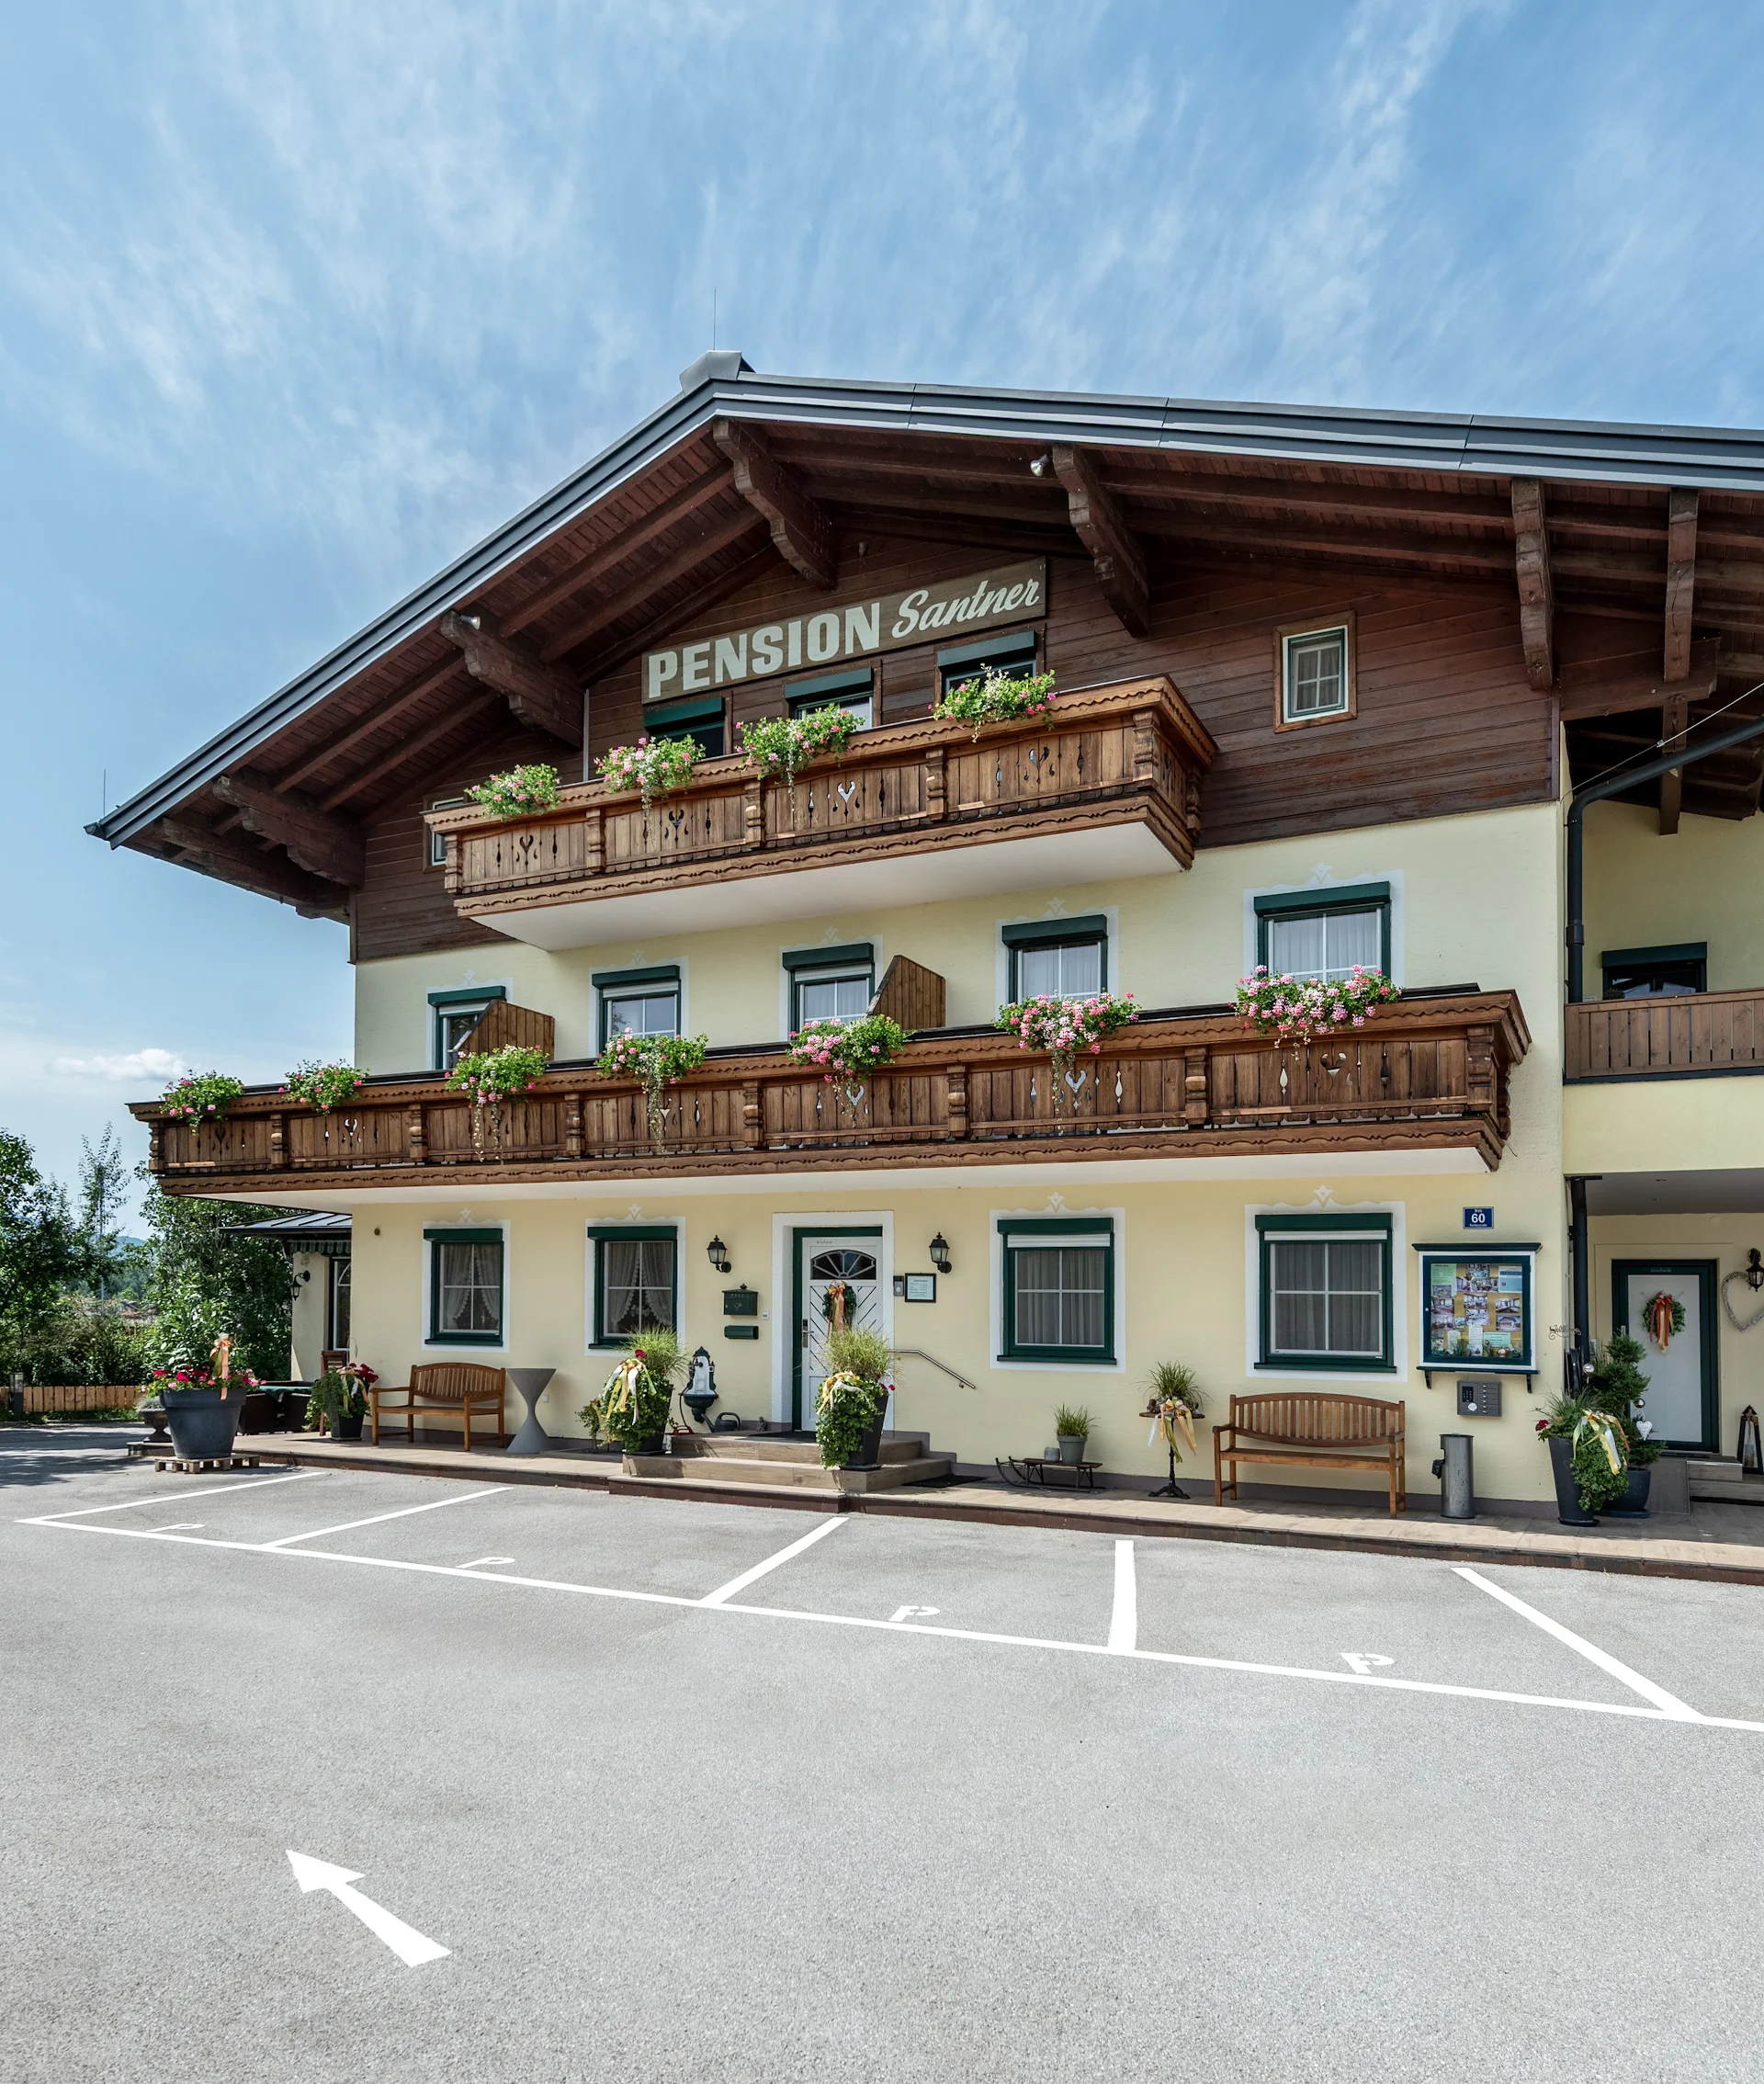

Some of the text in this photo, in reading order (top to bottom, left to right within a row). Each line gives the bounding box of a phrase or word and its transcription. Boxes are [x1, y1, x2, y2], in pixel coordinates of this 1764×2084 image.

[649, 579, 1040, 699] PENSION Santner
[1471, 1213, 1486, 1223] 60
[145, 1523, 205, 1533] P
[455, 1557, 515, 1569] P
[888, 1604, 941, 1623] P
[1340, 1652, 1396, 1675] P
